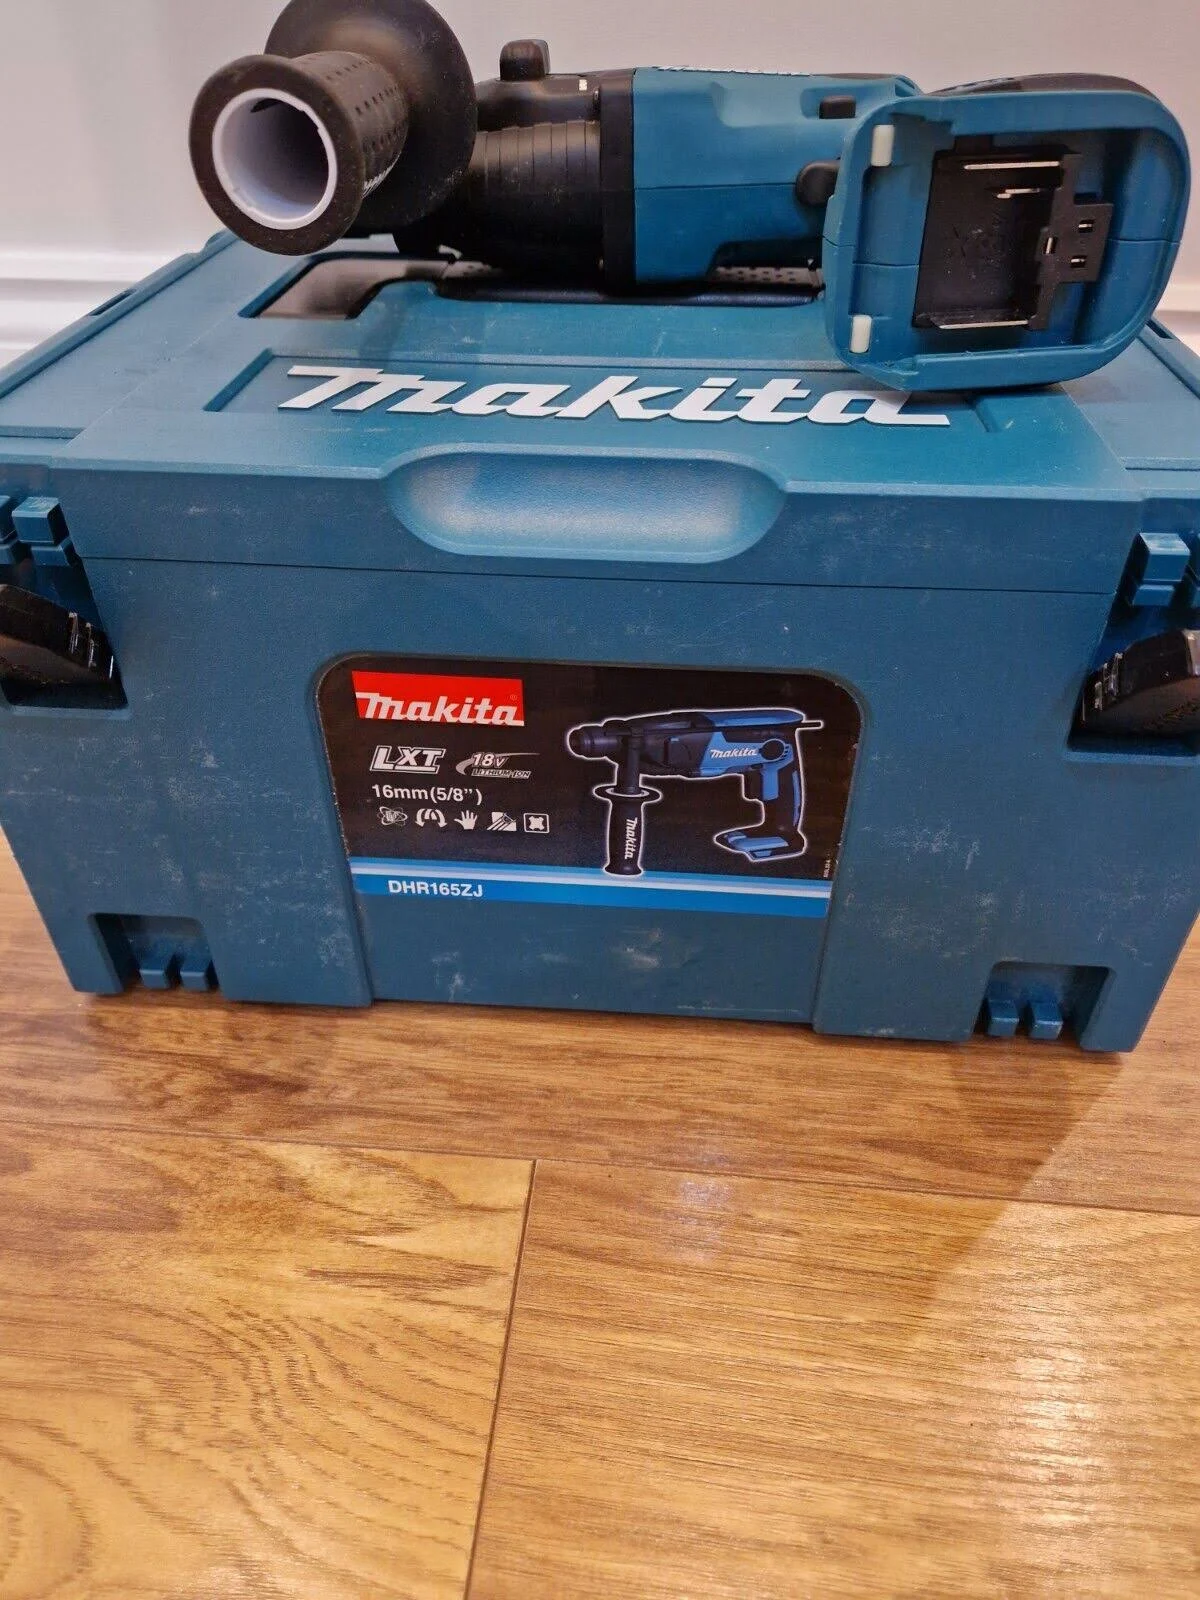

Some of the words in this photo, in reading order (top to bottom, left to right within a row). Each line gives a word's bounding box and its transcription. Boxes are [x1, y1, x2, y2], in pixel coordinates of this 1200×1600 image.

[278, 365, 950, 425] makita
[355, 691, 525, 727] makita
[370, 745, 446, 774] LXT
[709, 747, 757, 759] makita
[624, 817, 638, 860] makita
[388, 880, 484, 898] DHR165ZJ
